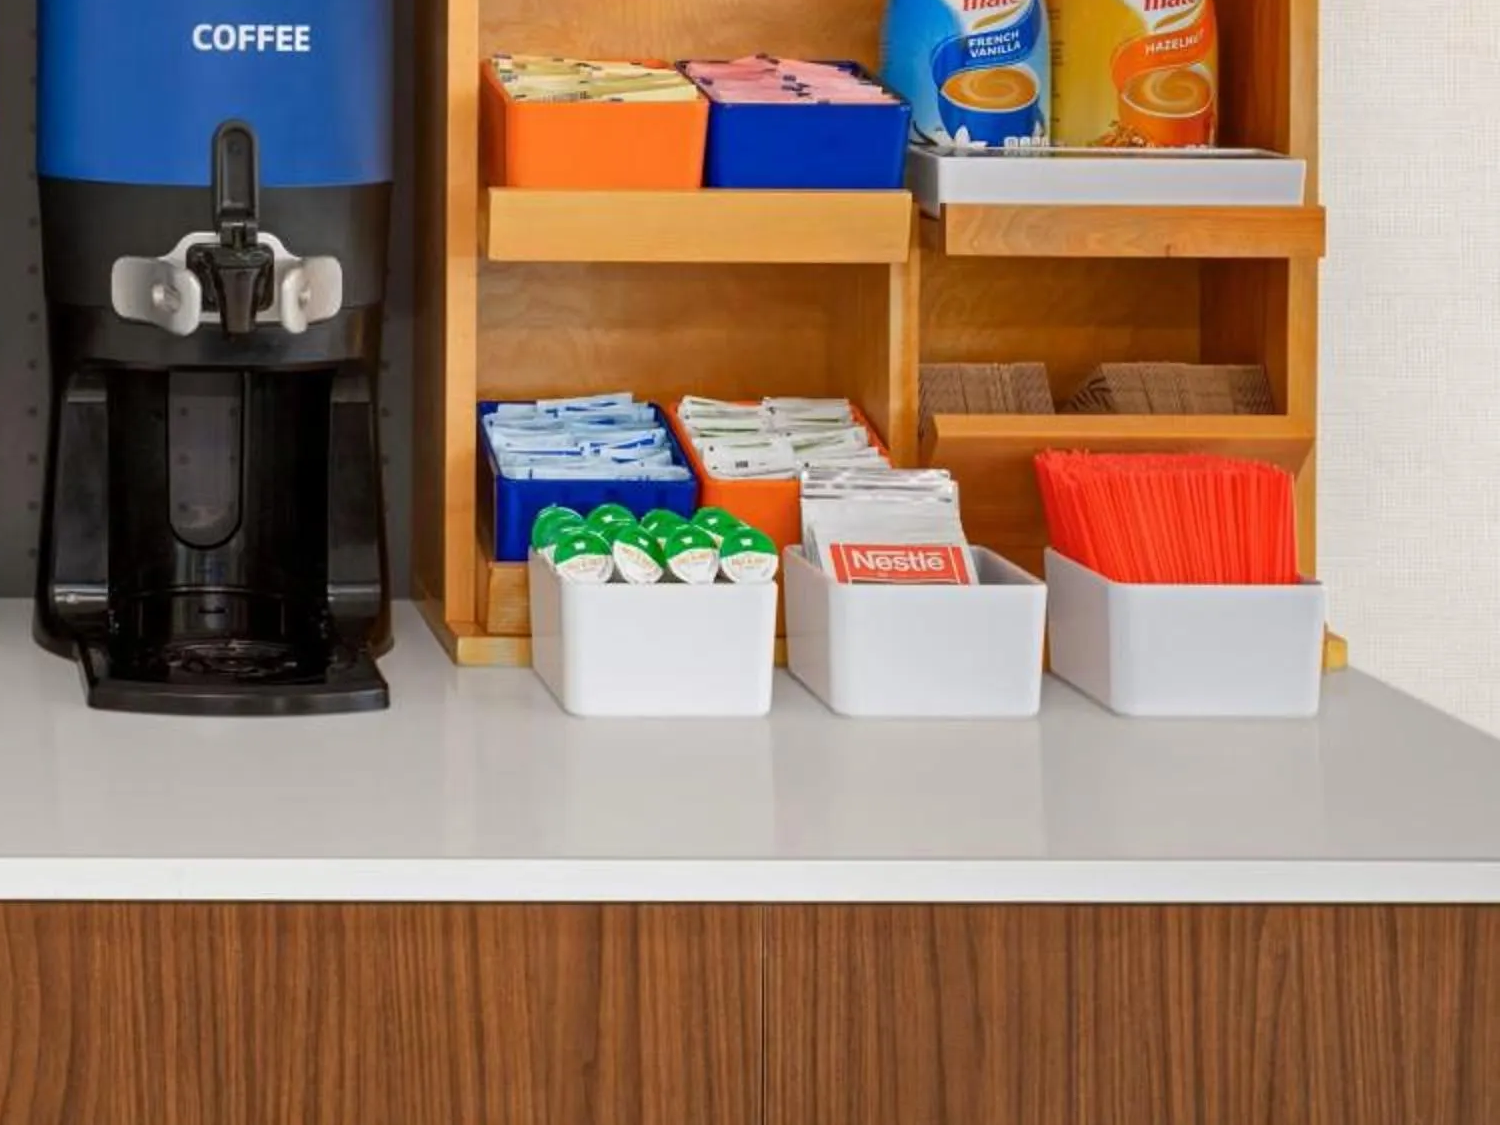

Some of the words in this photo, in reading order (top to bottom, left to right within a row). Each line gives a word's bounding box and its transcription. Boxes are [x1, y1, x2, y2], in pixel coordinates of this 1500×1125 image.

[192, 24, 311, 52] COFFEE
[968, 29, 1019, 48] FRENCH
[969, 40, 1021, 58] VANILLA
